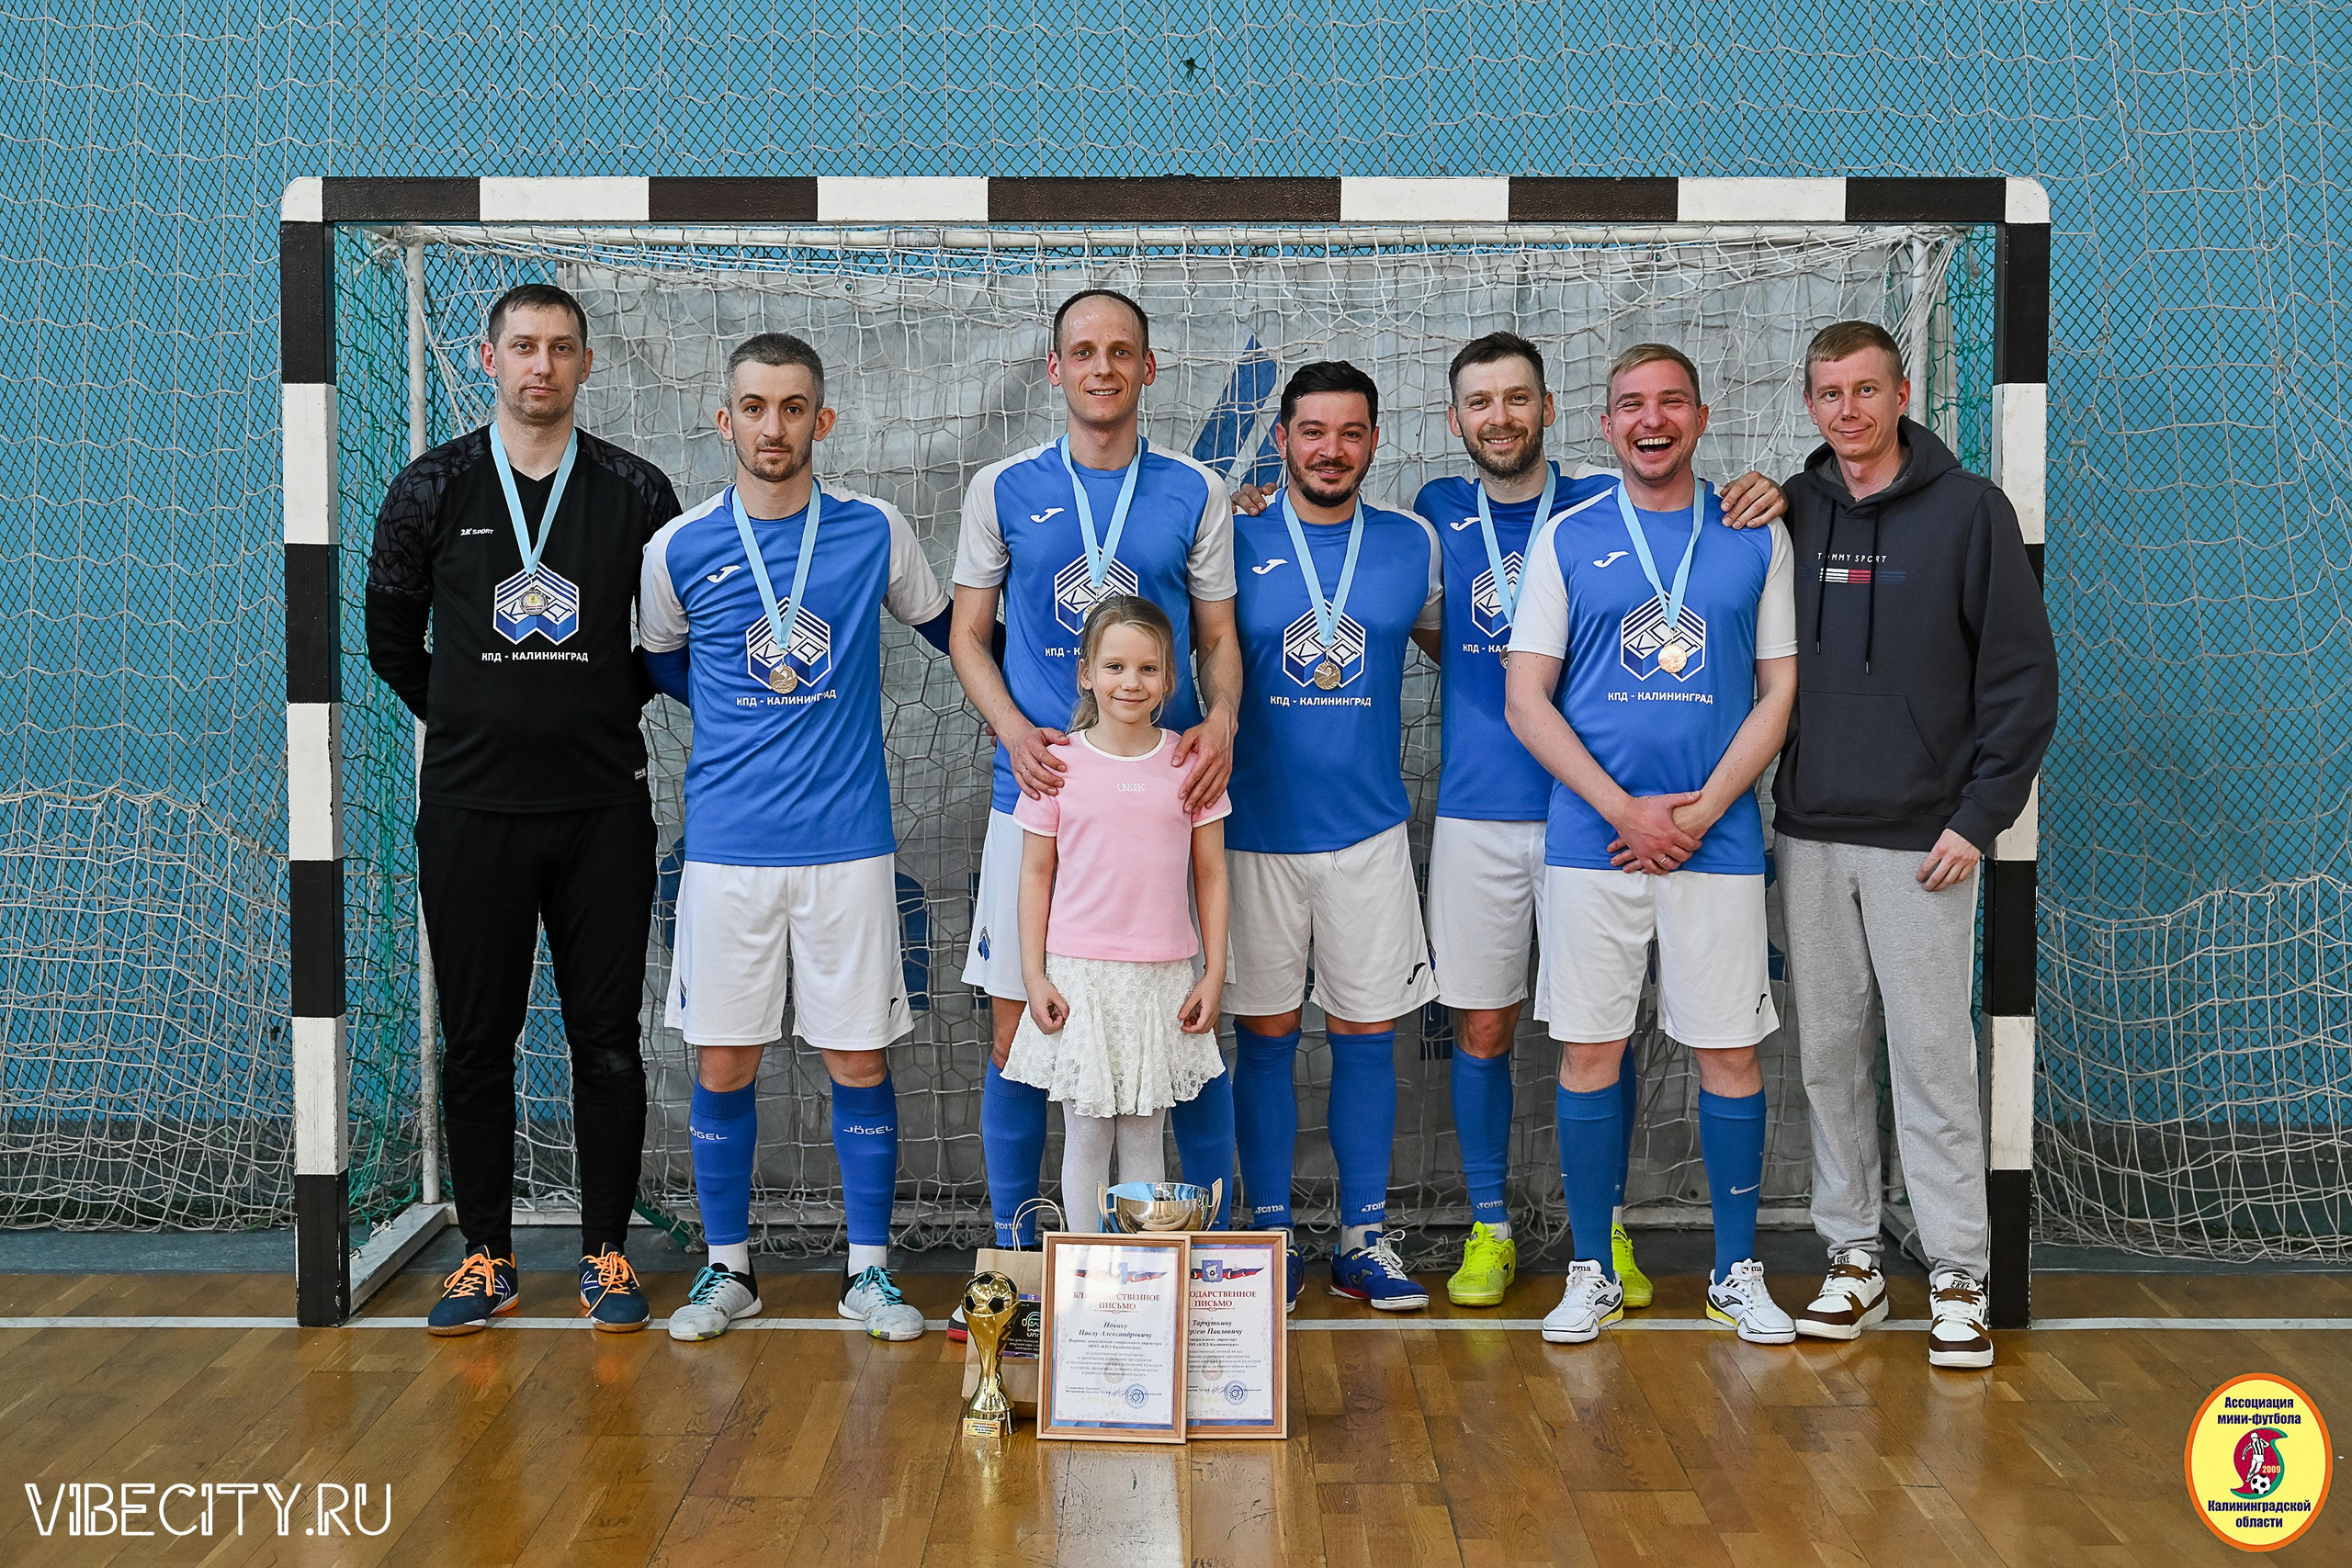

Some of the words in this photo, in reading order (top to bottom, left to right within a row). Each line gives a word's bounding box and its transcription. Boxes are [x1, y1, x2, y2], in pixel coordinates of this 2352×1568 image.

[1817, 552, 1851, 561] TMMY
[1046, 648, 1065, 658] КПД
[1463, 644, 1479, 653] КПД
[481, 652, 502, 662] КПД
[512, 651, 589, 662] КАЛИНИНГРАД
[736, 697, 757, 707] КПД
[1270, 695, 1290, 706] КПД
[1300, 697, 1372, 706] КАЛИНИНГРАД
[1608, 692, 1628, 702] КПД
[1637, 692, 1713, 705] КАЛИНИНГРАД
[842, 1125, 893, 1135] JÖGEL
[1099, 1302, 1136, 1310] ПИСЬМО
